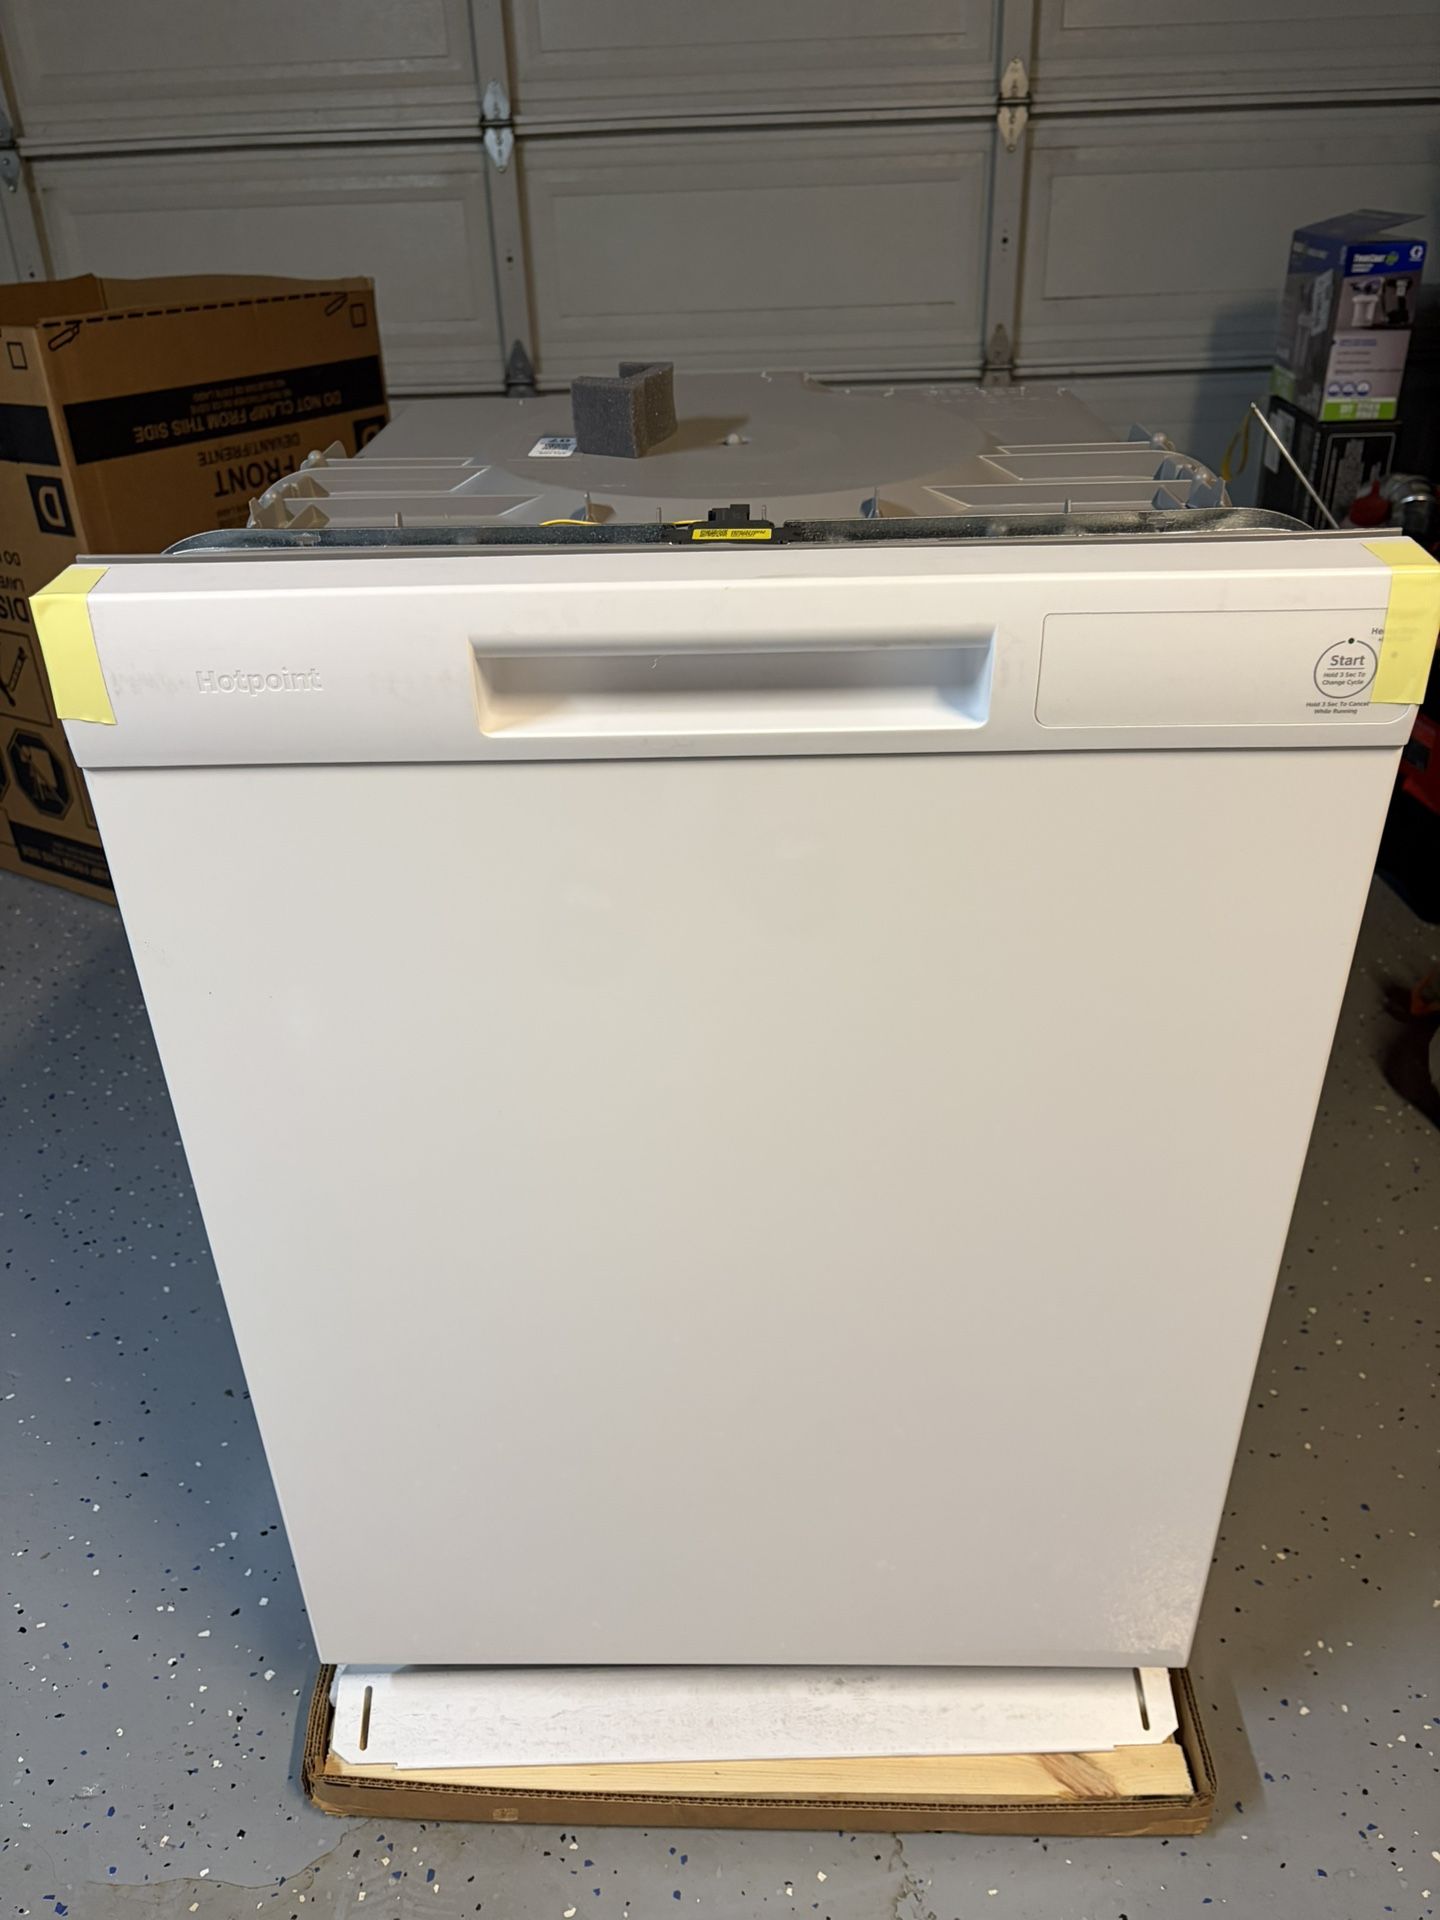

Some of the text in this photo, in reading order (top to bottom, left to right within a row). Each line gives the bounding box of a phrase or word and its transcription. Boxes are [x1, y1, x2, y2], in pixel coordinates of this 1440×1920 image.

[249, 399, 294, 422] CLAMP
[296, 393, 321, 413] NOT
[172, 416, 204, 436] THIS
[207, 407, 246, 430] FROM
[133, 420, 169, 444] SIDE
[197, 433, 300, 467] DEVANT/FRENTE
[1330, 655, 1365, 666] Start
[195, 667, 323, 697] Hotpoint
